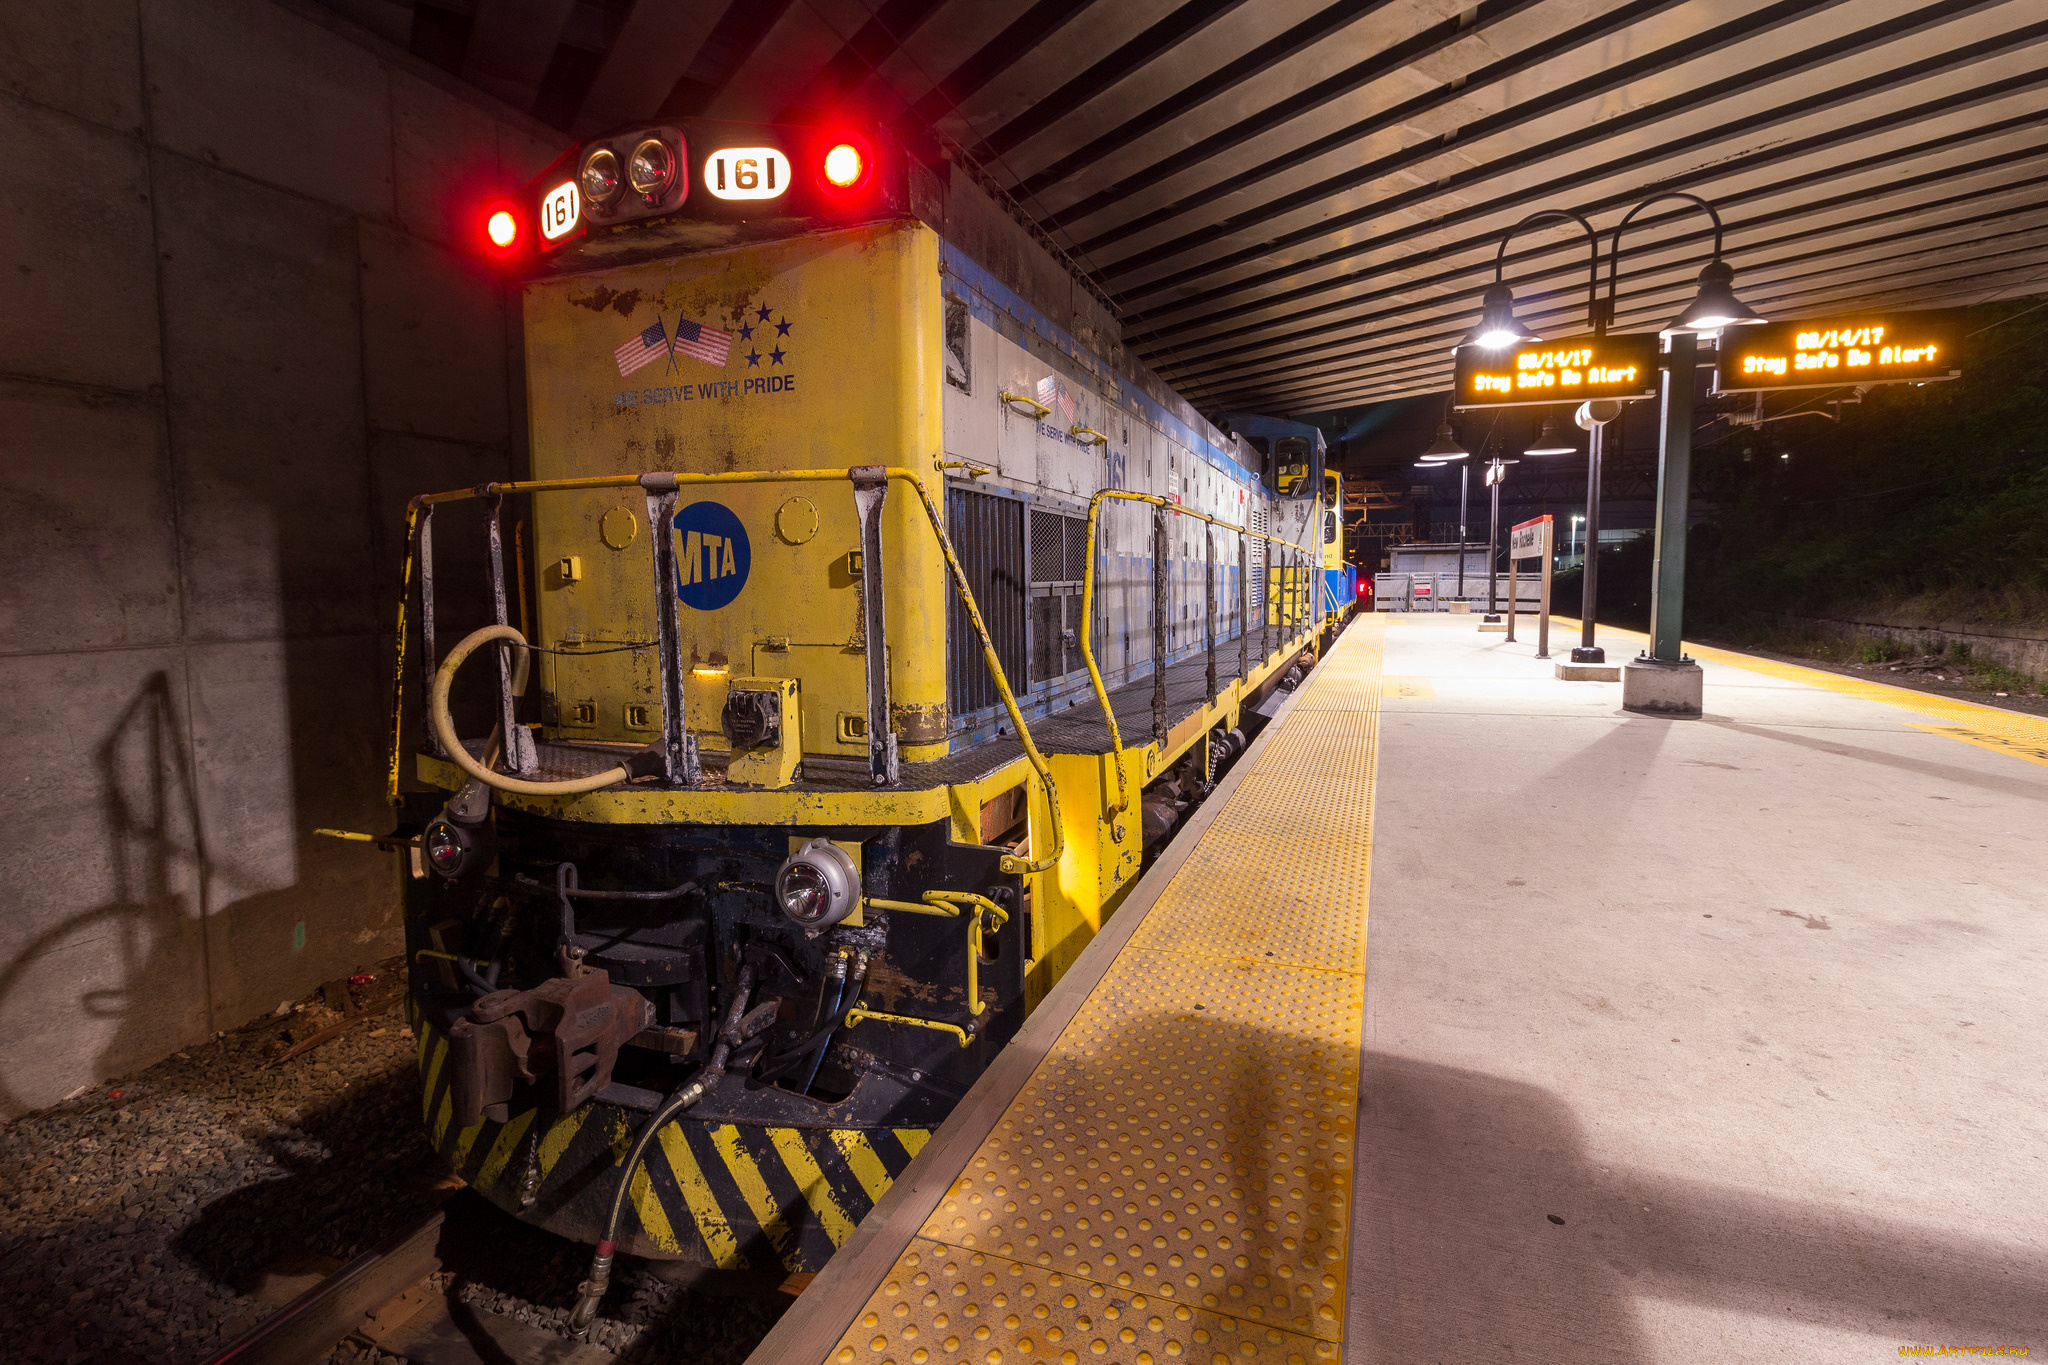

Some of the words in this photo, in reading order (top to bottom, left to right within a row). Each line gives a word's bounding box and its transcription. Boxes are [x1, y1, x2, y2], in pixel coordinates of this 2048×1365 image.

[716, 157, 776, 191] 161
[546, 189, 575, 232] 161
[1743, 356, 1787, 374] Stay
[1795, 351, 1839, 370] Safe
[1847, 349, 1871, 366] Be
[1879, 345, 1937, 364] Alert
[614, 391, 638, 407] WE
[643, 385, 693, 405] SERVE
[698, 380, 738, 399] WITH
[744, 374, 795, 395] PRIDE
[1474, 375, 1511, 392] Stay
[1517, 370, 1554, 388] Safe
[1561, 369, 1581, 385] Be
[1588, 366, 1637, 383] Alert
[1036, 421, 1045, 436] WE
[1046, 425, 1063, 443] SERVE
[1106, 448, 1126, 507] 161
[674, 527, 736, 587] MTA
